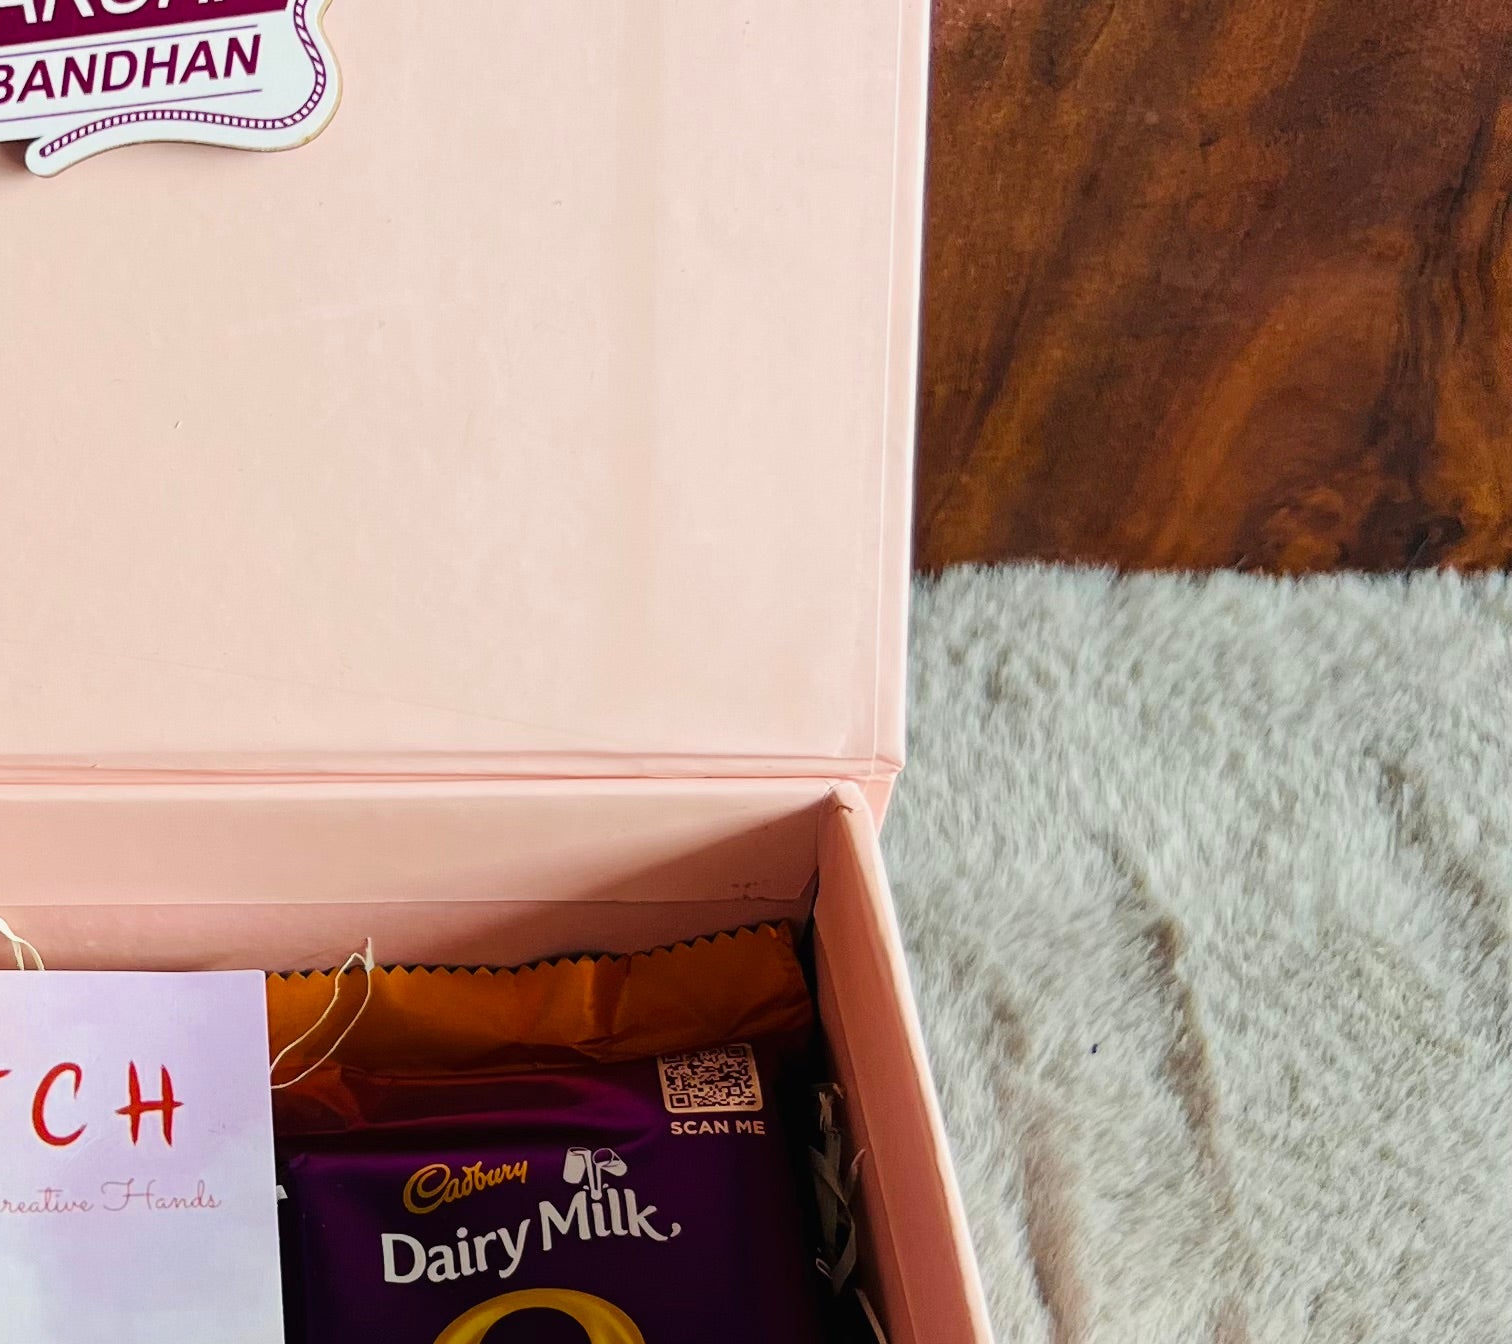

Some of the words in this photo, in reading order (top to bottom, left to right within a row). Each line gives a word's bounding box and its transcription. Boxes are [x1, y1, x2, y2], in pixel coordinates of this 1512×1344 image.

[670, 1120, 729, 1136] SCAN
[736, 1119, 766, 1136] ME
[101, 1176, 223, 1213] Hands
[402, 1160, 529, 1214] Cadbury
[380, 1218, 531, 1284] Dairy
